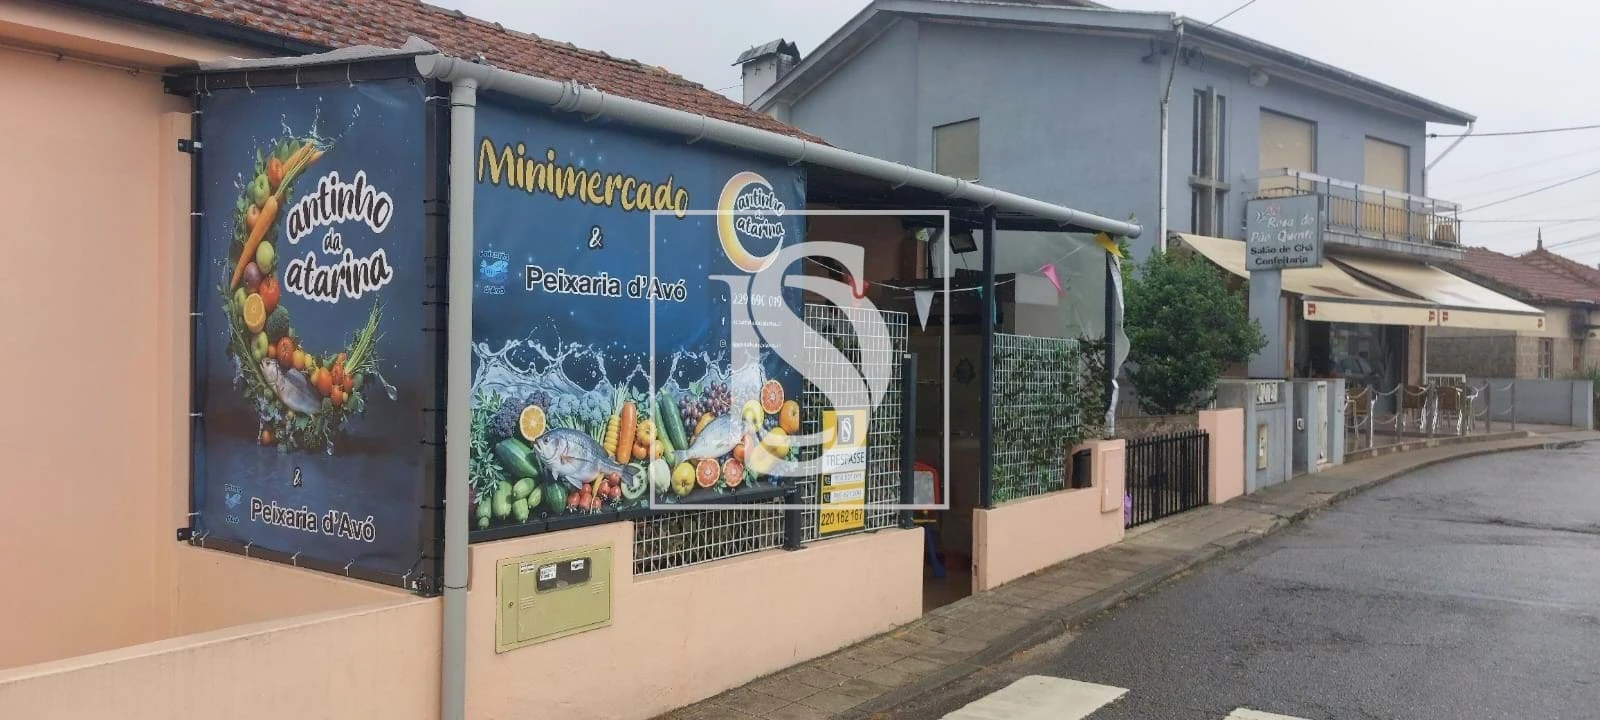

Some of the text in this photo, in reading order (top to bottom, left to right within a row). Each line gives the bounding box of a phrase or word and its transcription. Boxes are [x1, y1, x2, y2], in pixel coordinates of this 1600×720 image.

[477, 137, 689, 218] Minimercado
[323, 227, 342, 254] da
[588, 225, 604, 249] &
[1255, 255, 1308, 265] Confeitaria
[525, 264, 621, 297] Peixaria
[293, 467, 302, 487] &
[250, 497, 318, 533] Peixaria
[821, 512, 835, 526] 220
